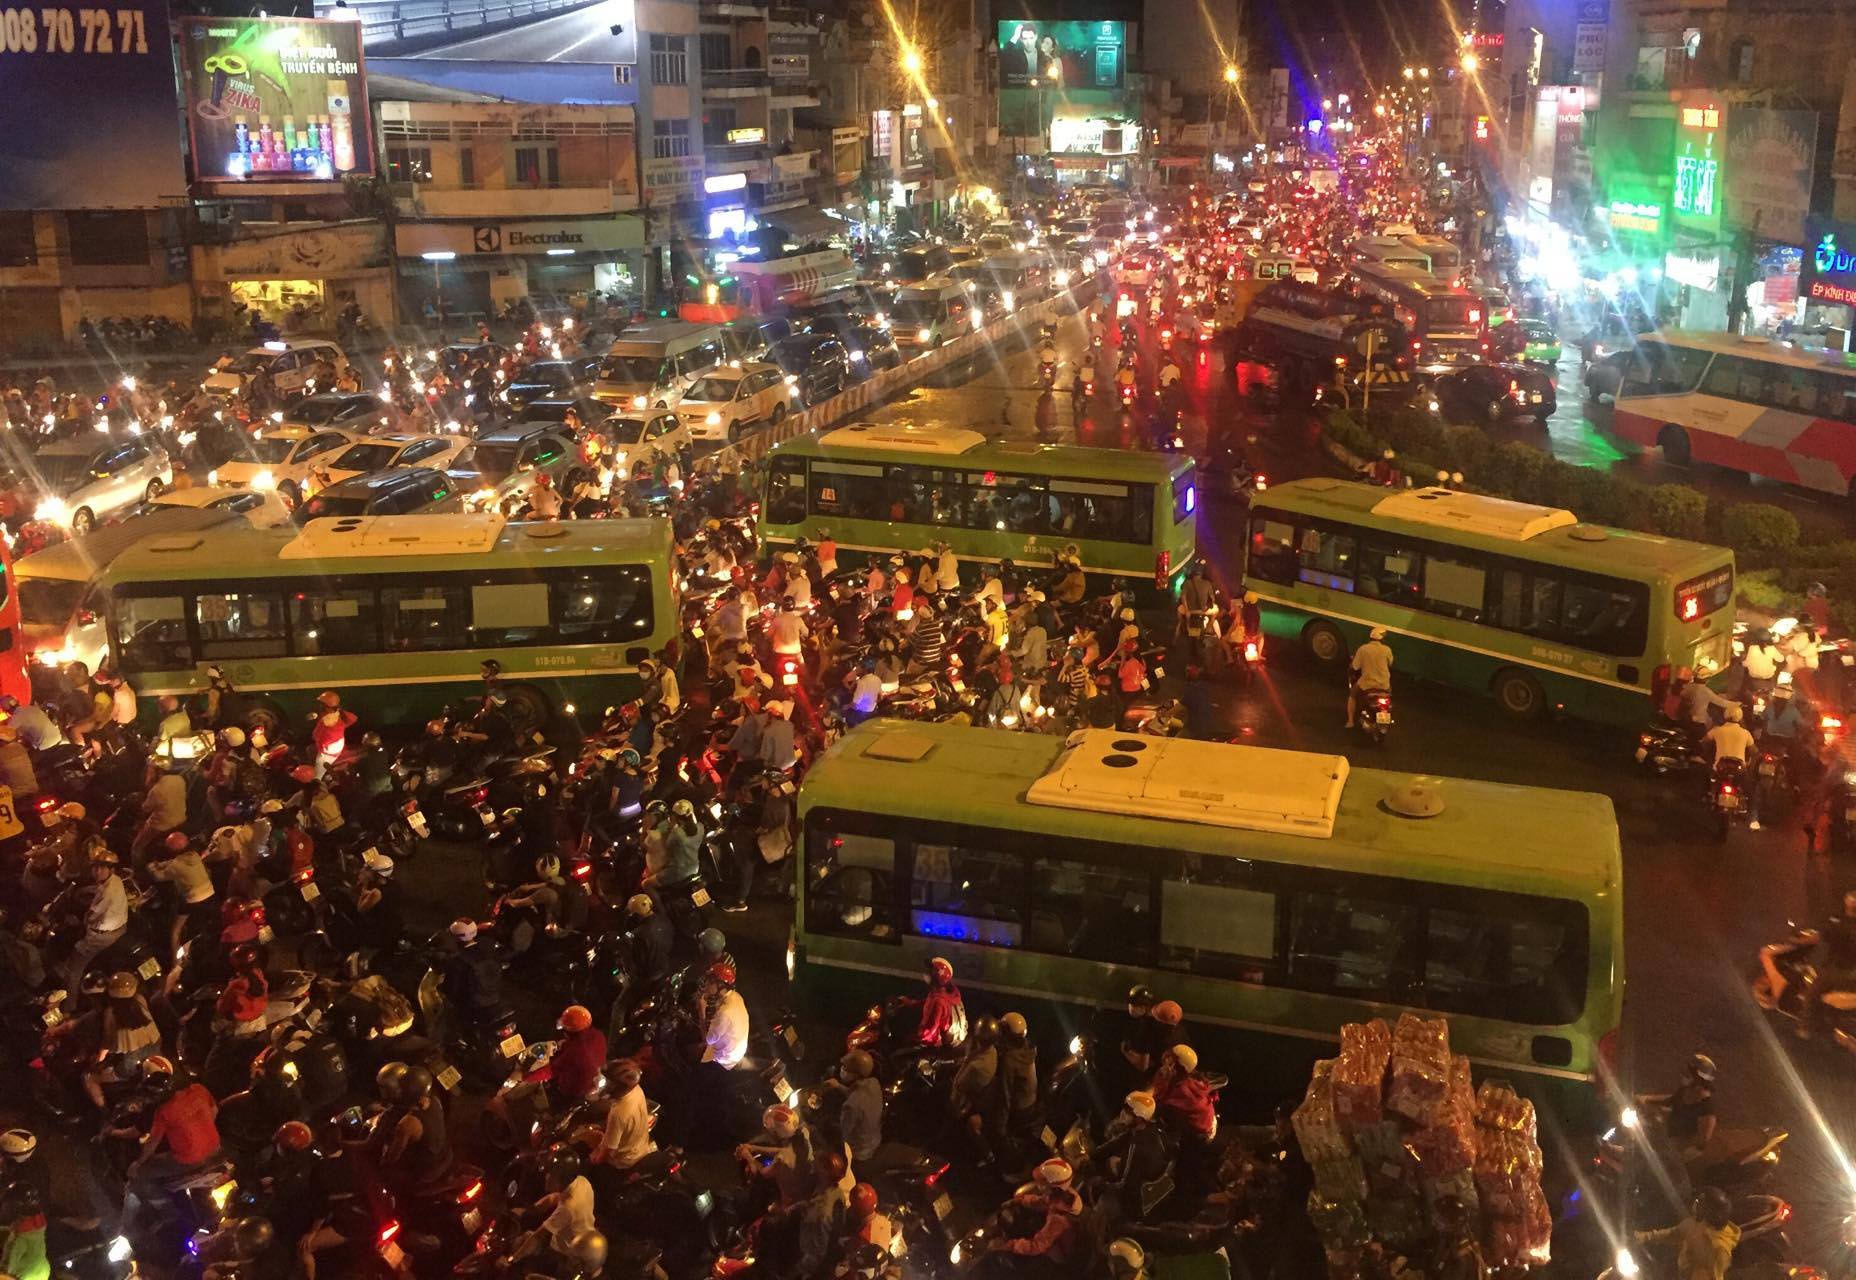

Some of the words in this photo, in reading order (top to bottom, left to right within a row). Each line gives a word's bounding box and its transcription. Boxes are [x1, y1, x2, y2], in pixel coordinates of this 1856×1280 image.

[42, 8, 75, 53] 70
[80, 9, 113, 53] 72
[117, 9, 148, 53] 71
[229, 79, 255, 93] VIRUS
[225, 89, 262, 113] ZIKA
[509, 230, 584, 246] Electrolux
